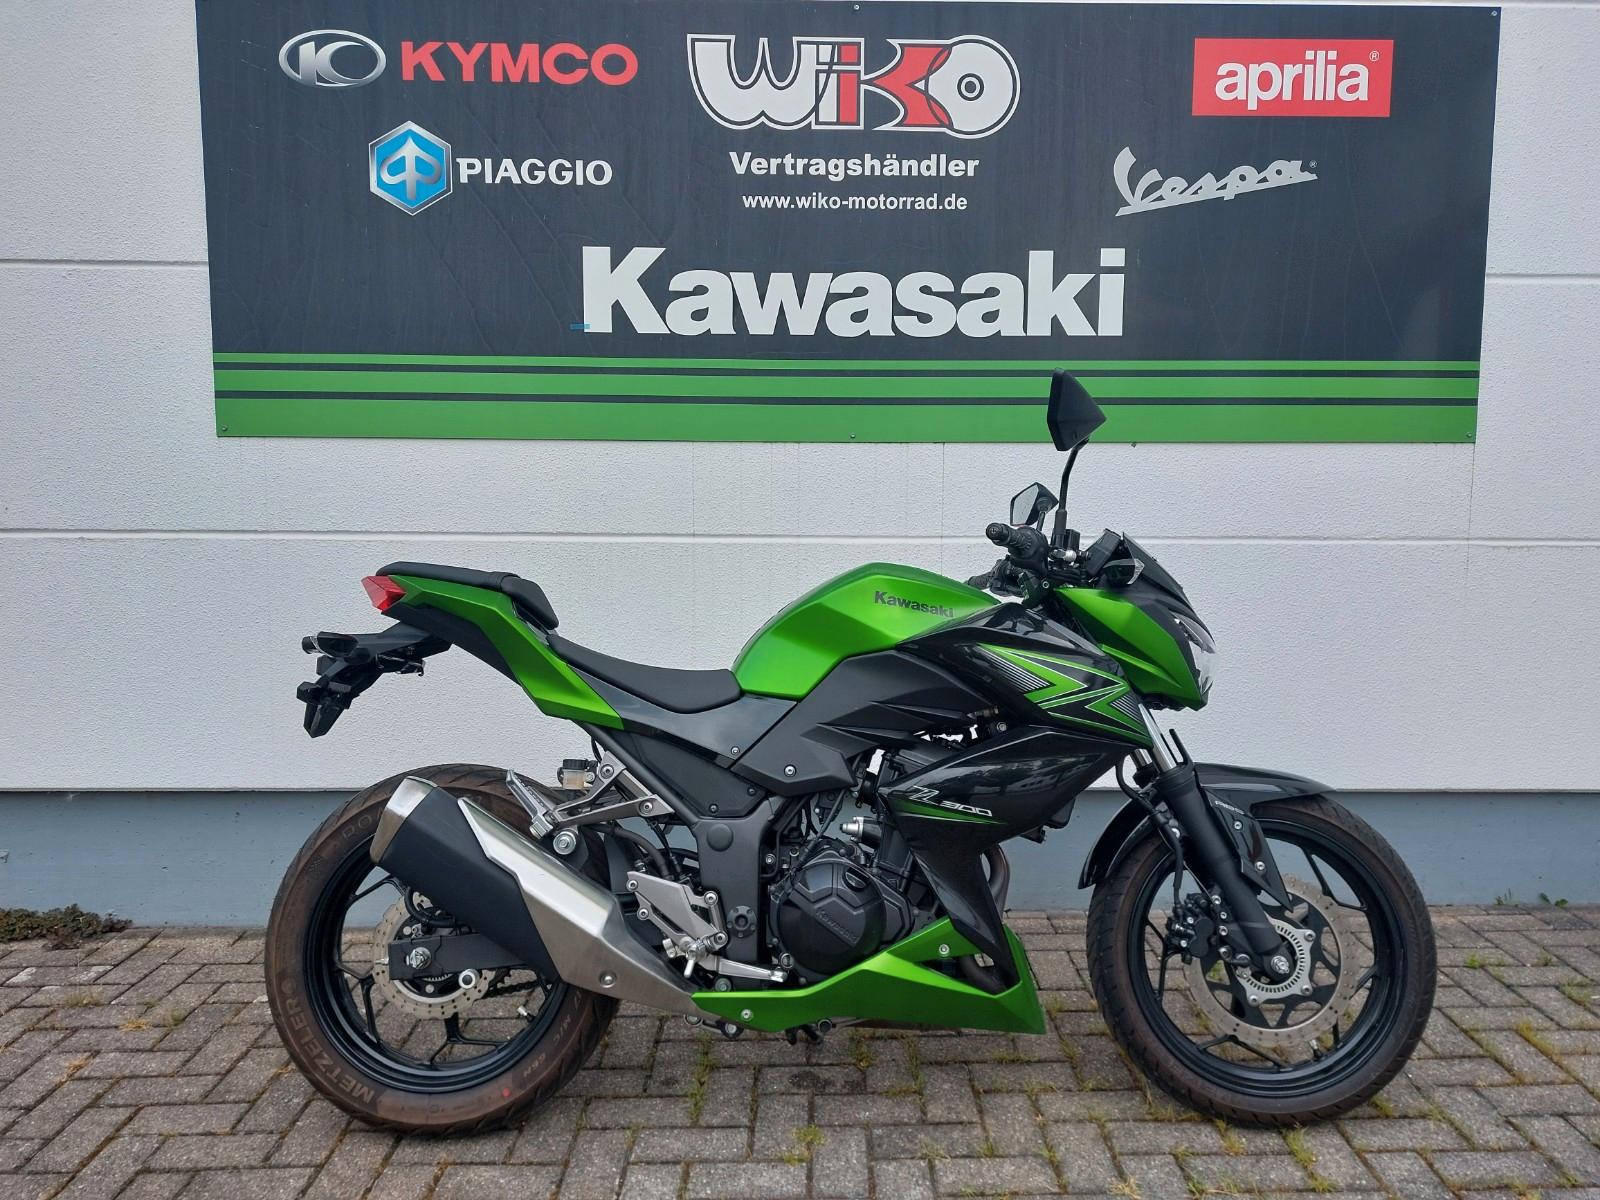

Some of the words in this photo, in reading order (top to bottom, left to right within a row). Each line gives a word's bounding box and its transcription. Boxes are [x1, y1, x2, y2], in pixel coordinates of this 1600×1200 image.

[401, 41, 638, 86] KYMCO
[456, 157, 613, 186] PIAGGIO
[729, 151, 980, 182] Vertragshändler
[1113, 146, 1318, 217] Vespa
[742, 192, 968, 211] www.wiko-motorrad.de
[582, 246, 1126, 338] Kawasaki
[874, 590, 954, 618] Kawasaki
[285, 997, 375, 1104] METZELER
